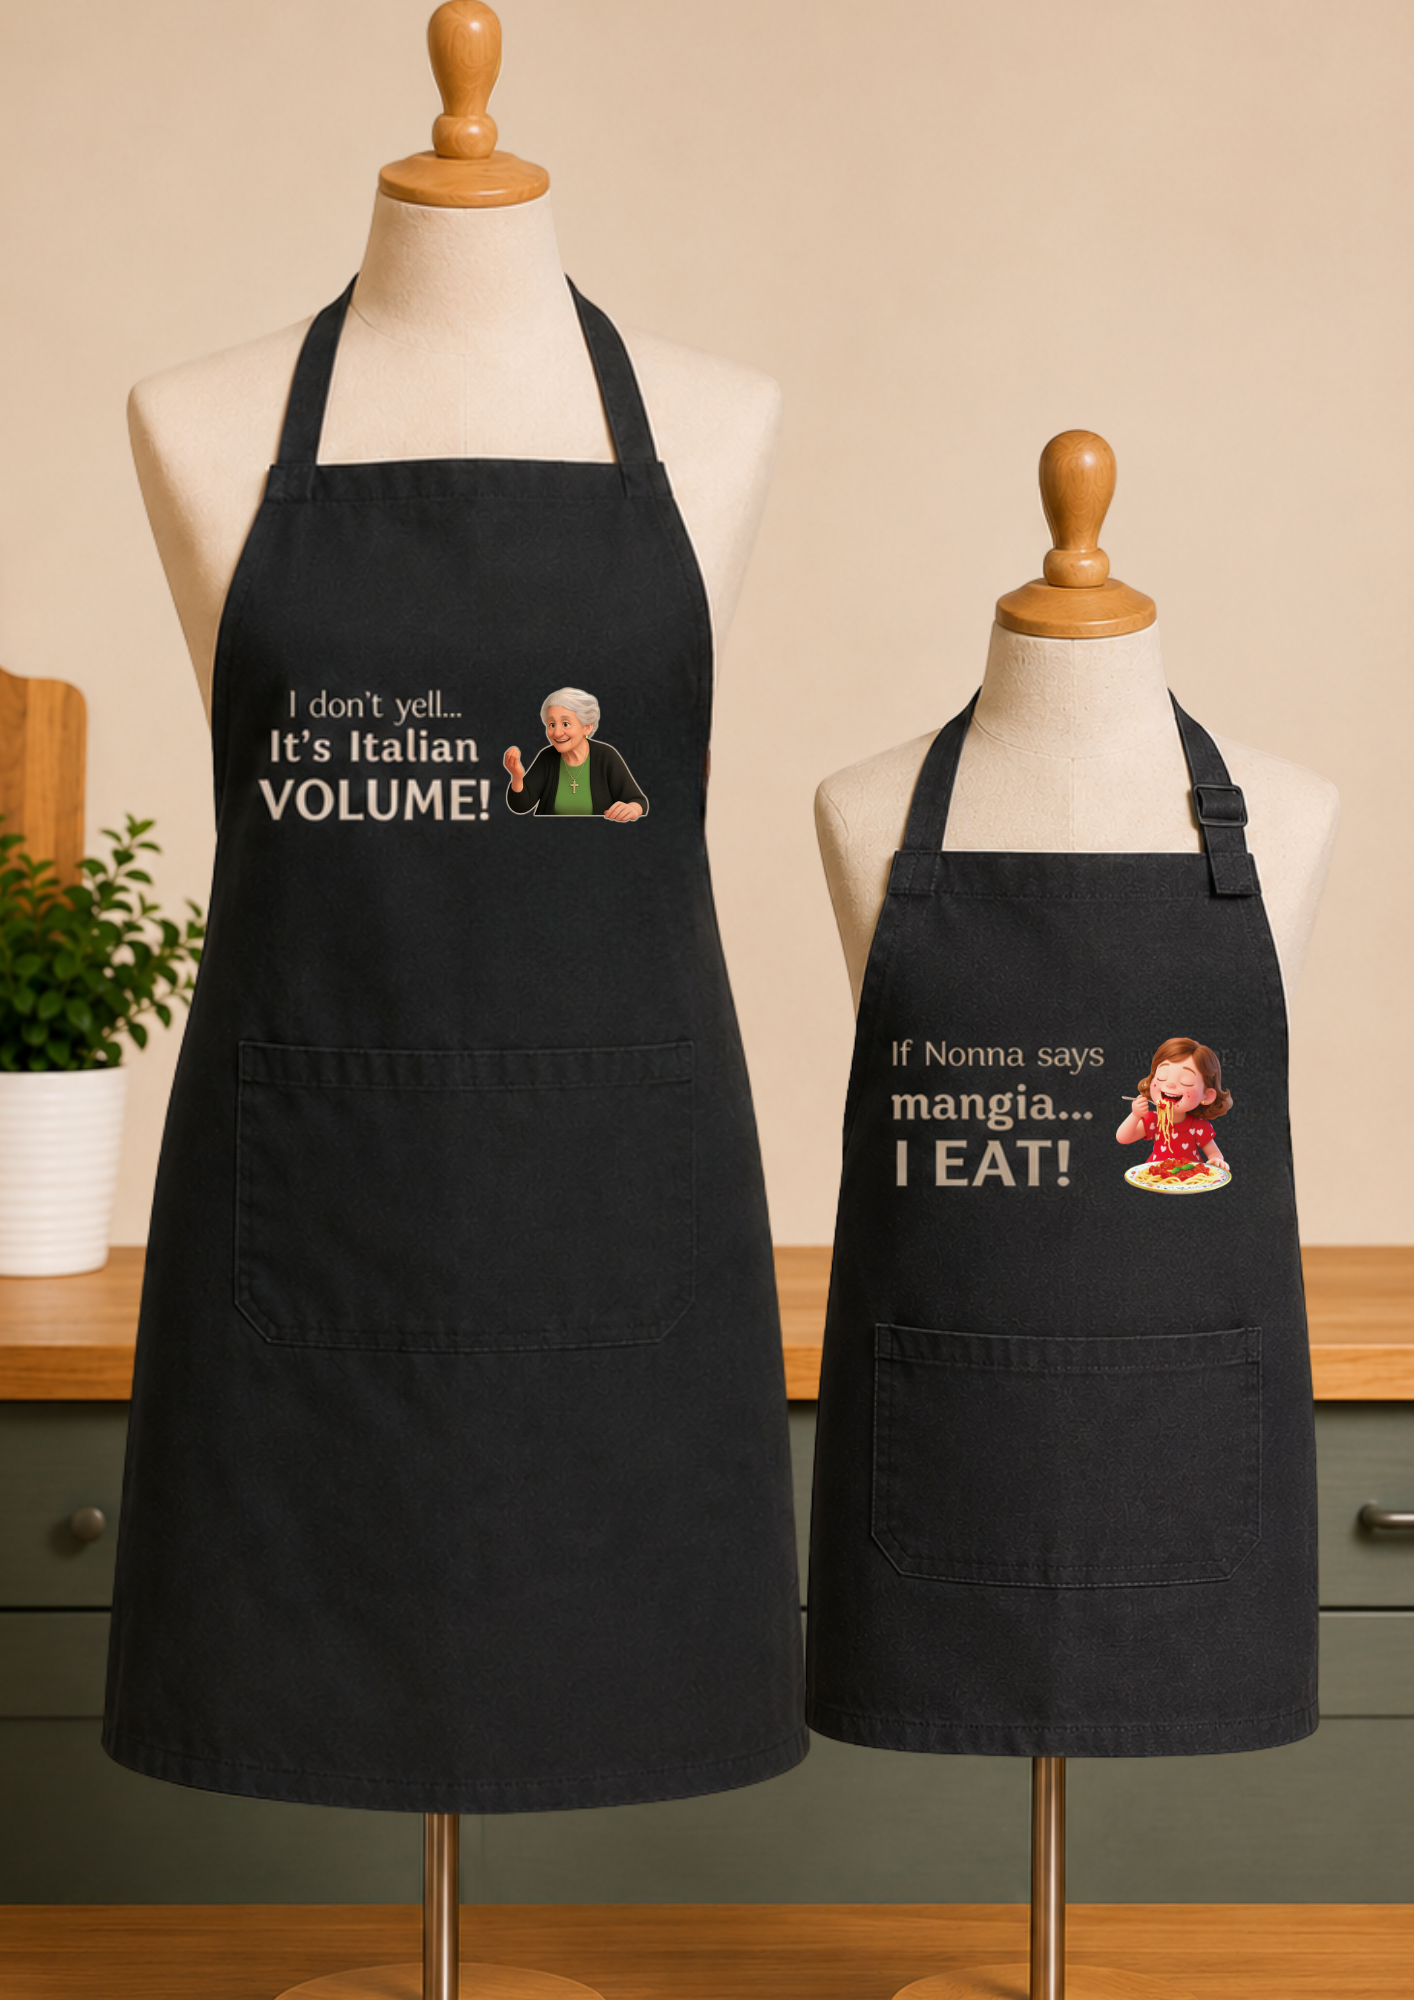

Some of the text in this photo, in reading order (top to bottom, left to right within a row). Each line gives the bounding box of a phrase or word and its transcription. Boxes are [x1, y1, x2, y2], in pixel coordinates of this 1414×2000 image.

[290, 690, 462, 727] I don't yell...
[270, 728, 480, 763] It's Italian
[258, 778, 491, 821] VOLUME!
[892, 1039, 913, 1067] If
[925, 1041, 1026, 1067] Nonna
[1037, 1047, 1105, 1076] says
[891, 1083, 1093, 1131] mangia...
[896, 1140, 1071, 1187] I EAT!
